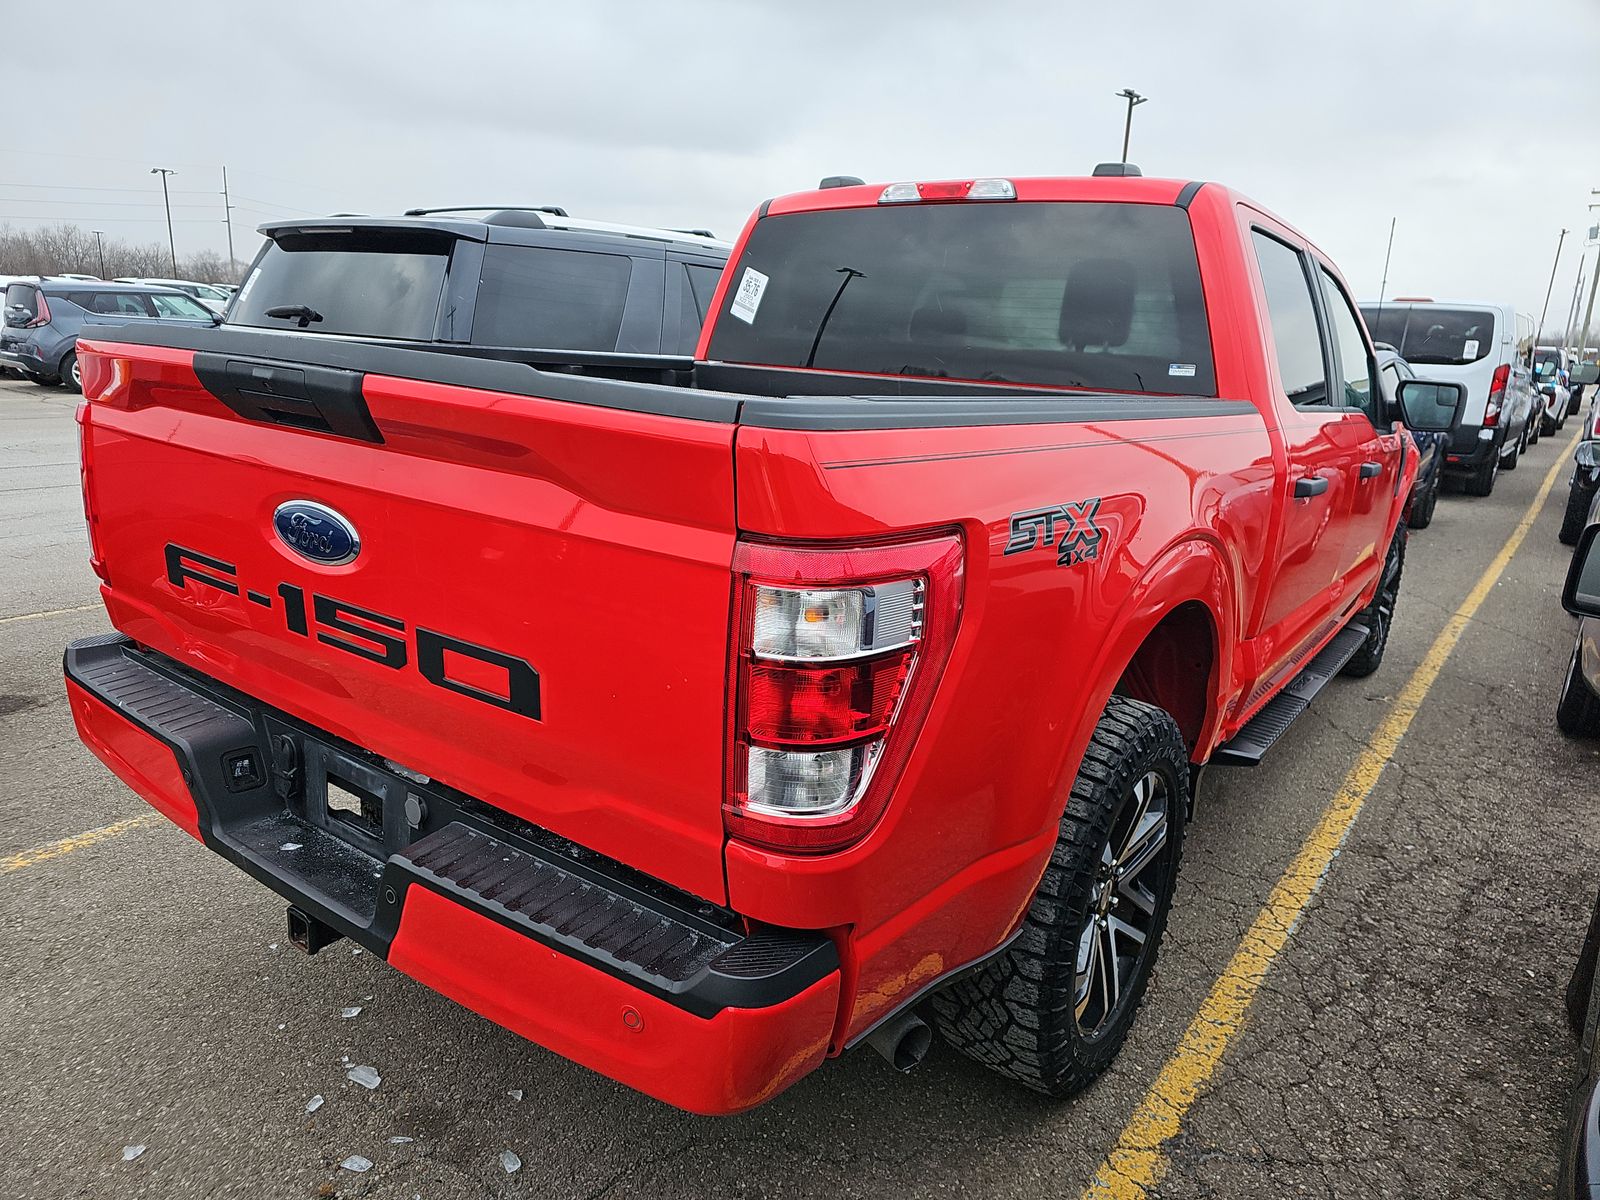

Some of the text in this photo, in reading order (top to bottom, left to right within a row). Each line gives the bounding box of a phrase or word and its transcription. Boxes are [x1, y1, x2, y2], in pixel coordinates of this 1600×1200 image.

[286, 512, 334, 554] Ford
[1003, 497, 1102, 557] STX
[1057, 544, 1098, 568] 4x4
[164, 542, 542, 721] F-150
